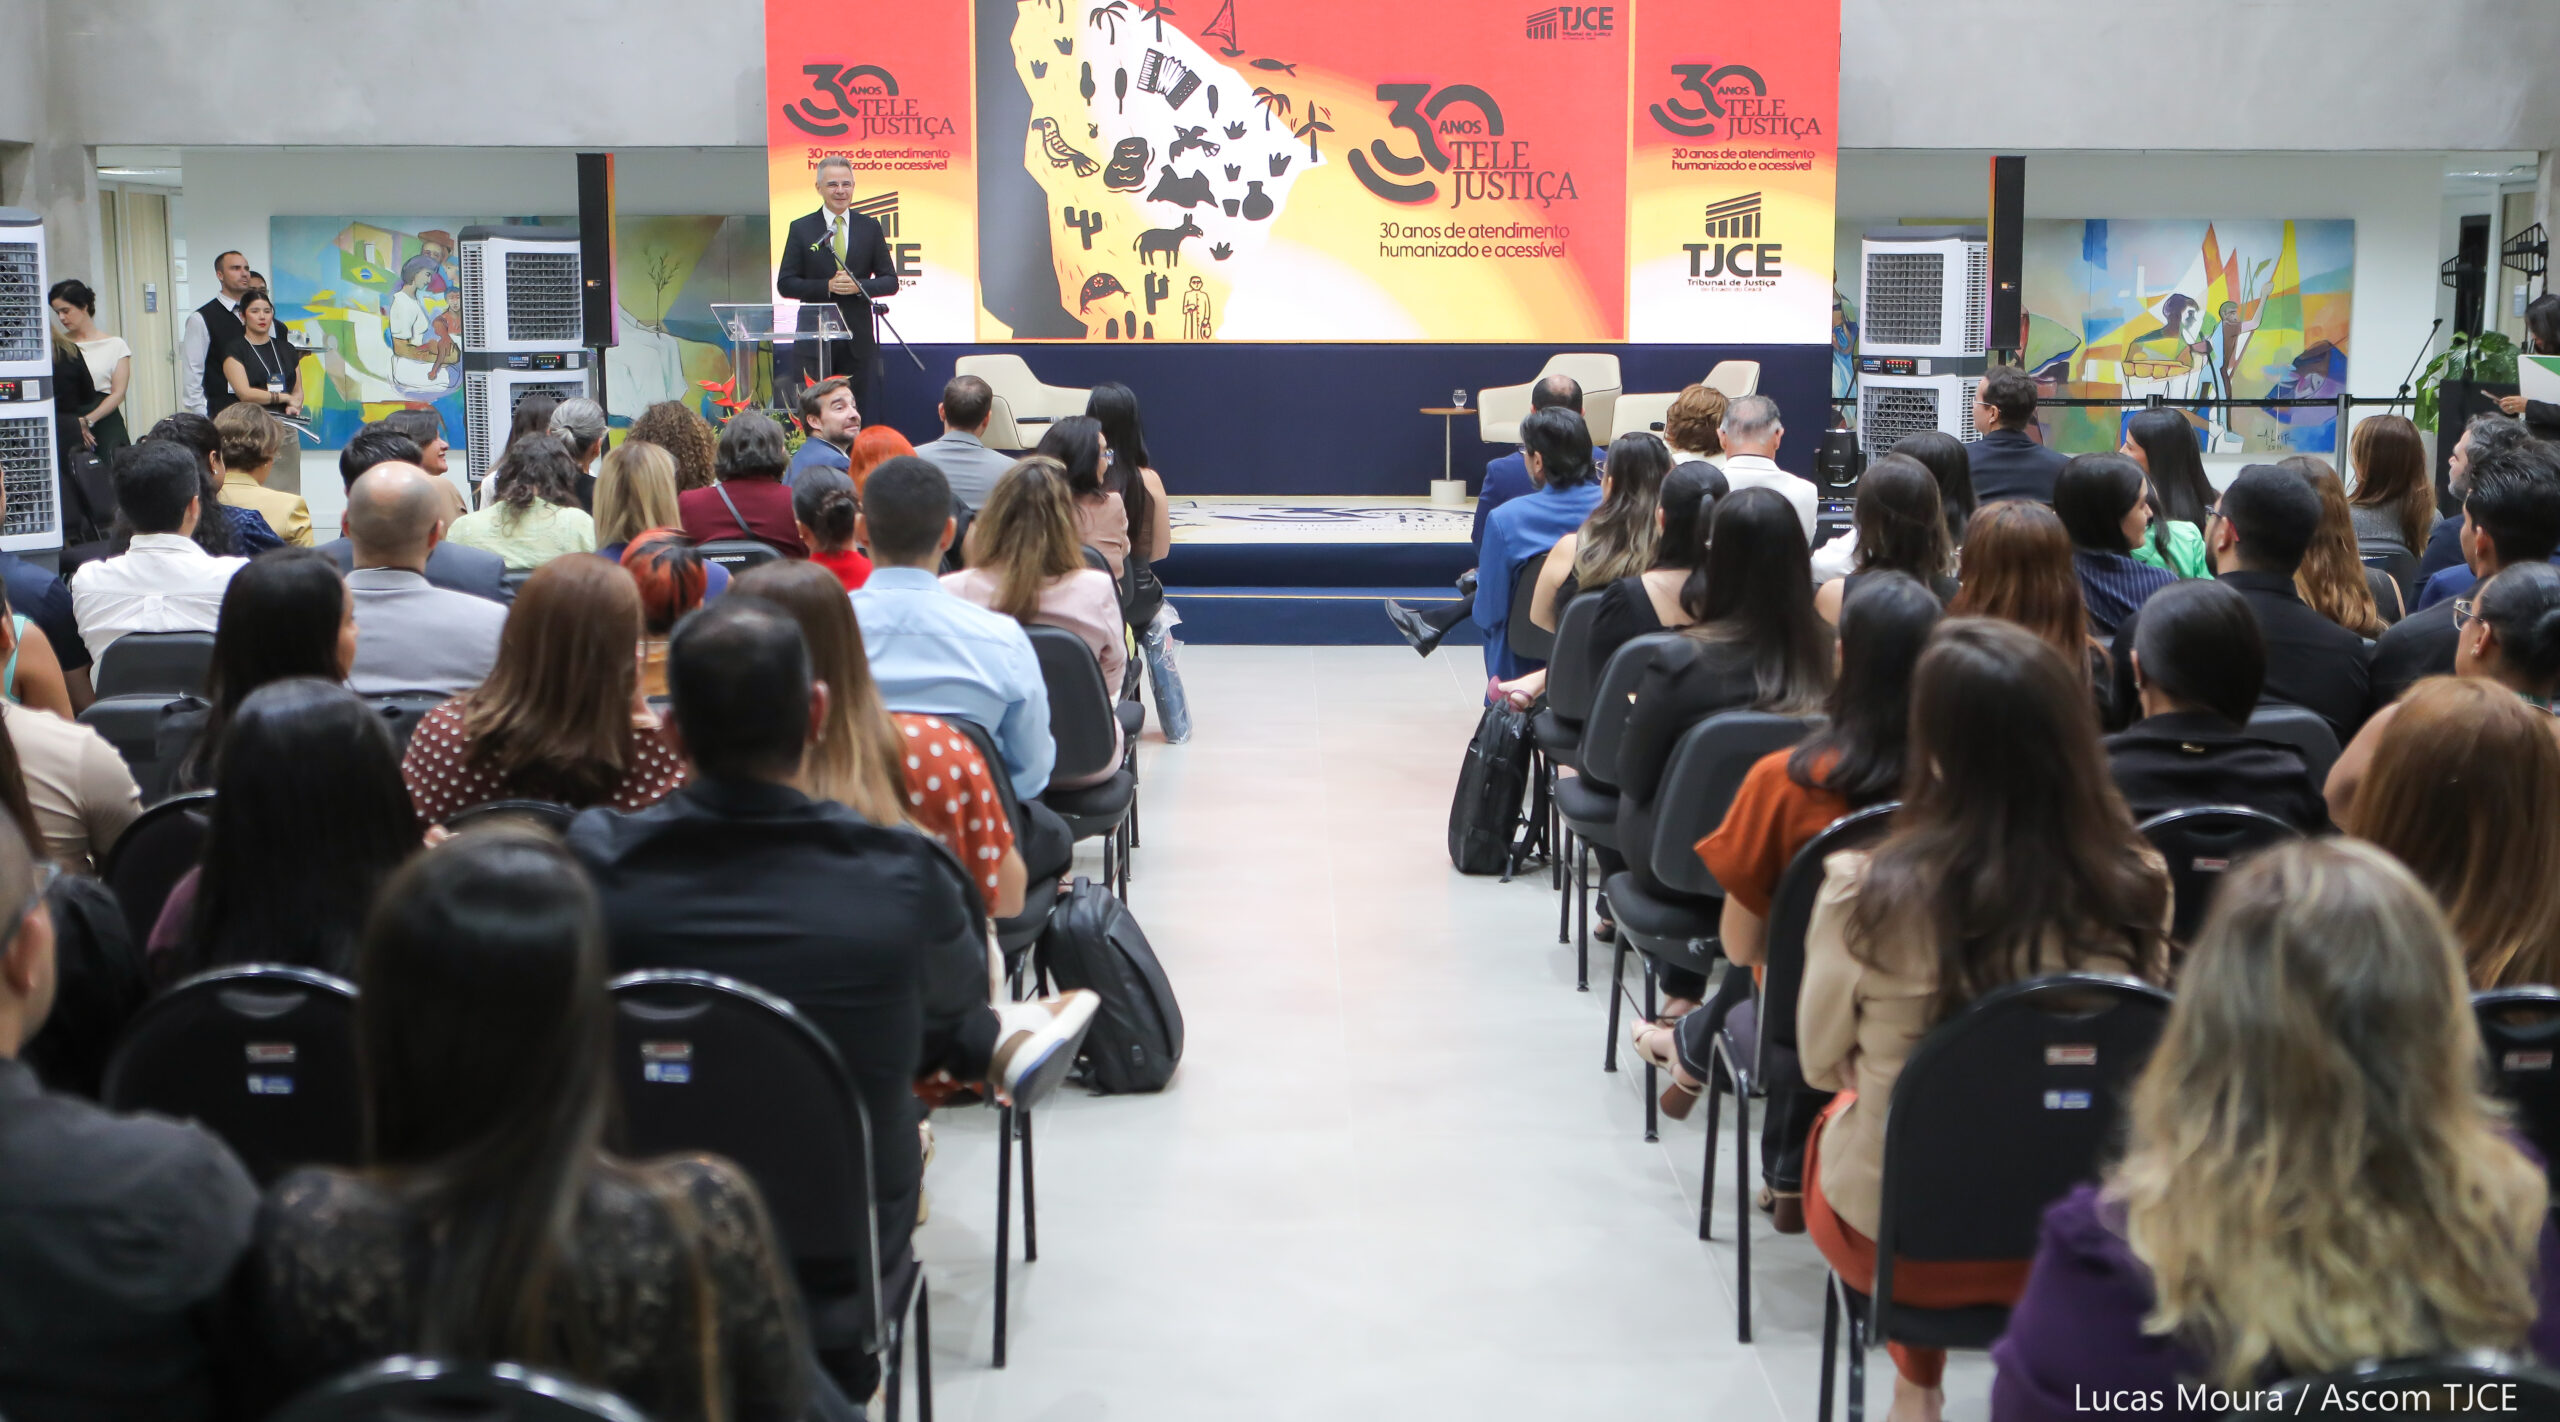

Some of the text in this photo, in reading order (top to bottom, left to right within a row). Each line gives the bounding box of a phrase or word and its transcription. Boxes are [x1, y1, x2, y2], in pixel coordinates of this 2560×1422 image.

[1558, 6, 1614, 31] TJCE
[849, 86, 882, 95] ANOS
[1717, 86, 1750, 95] ANOS
[783, 64, 900, 137] 30
[857, 99, 919, 117] TELE
[1650, 64, 1767, 137] 30
[1725, 99, 1786, 117] TELE
[861, 117, 956, 140] JUSTIÇA
[1438, 120, 1482, 135] ANOS
[1726, 117, 1822, 141] JUSTIÇA
[1347, 83, 1505, 203] 30
[807, 148, 950, 159] 30 anos de atendimento
[1448, 141, 1530, 170] TELE
[1672, 148, 1816, 159] 30 anos de atendimento
[808, 159, 947, 170] hizado e acessível
[1671, 160, 1812, 171] humanizado e acessível
[1450, 170, 1579, 209] JUSTIÇA
[1379, 222, 1570, 239] 30 anos de atendimento
[1379, 241, 1566, 258] humanizado e acessível
[1682, 243, 1783, 278] TJCE
[1744, 279, 1777, 287] Justiça
